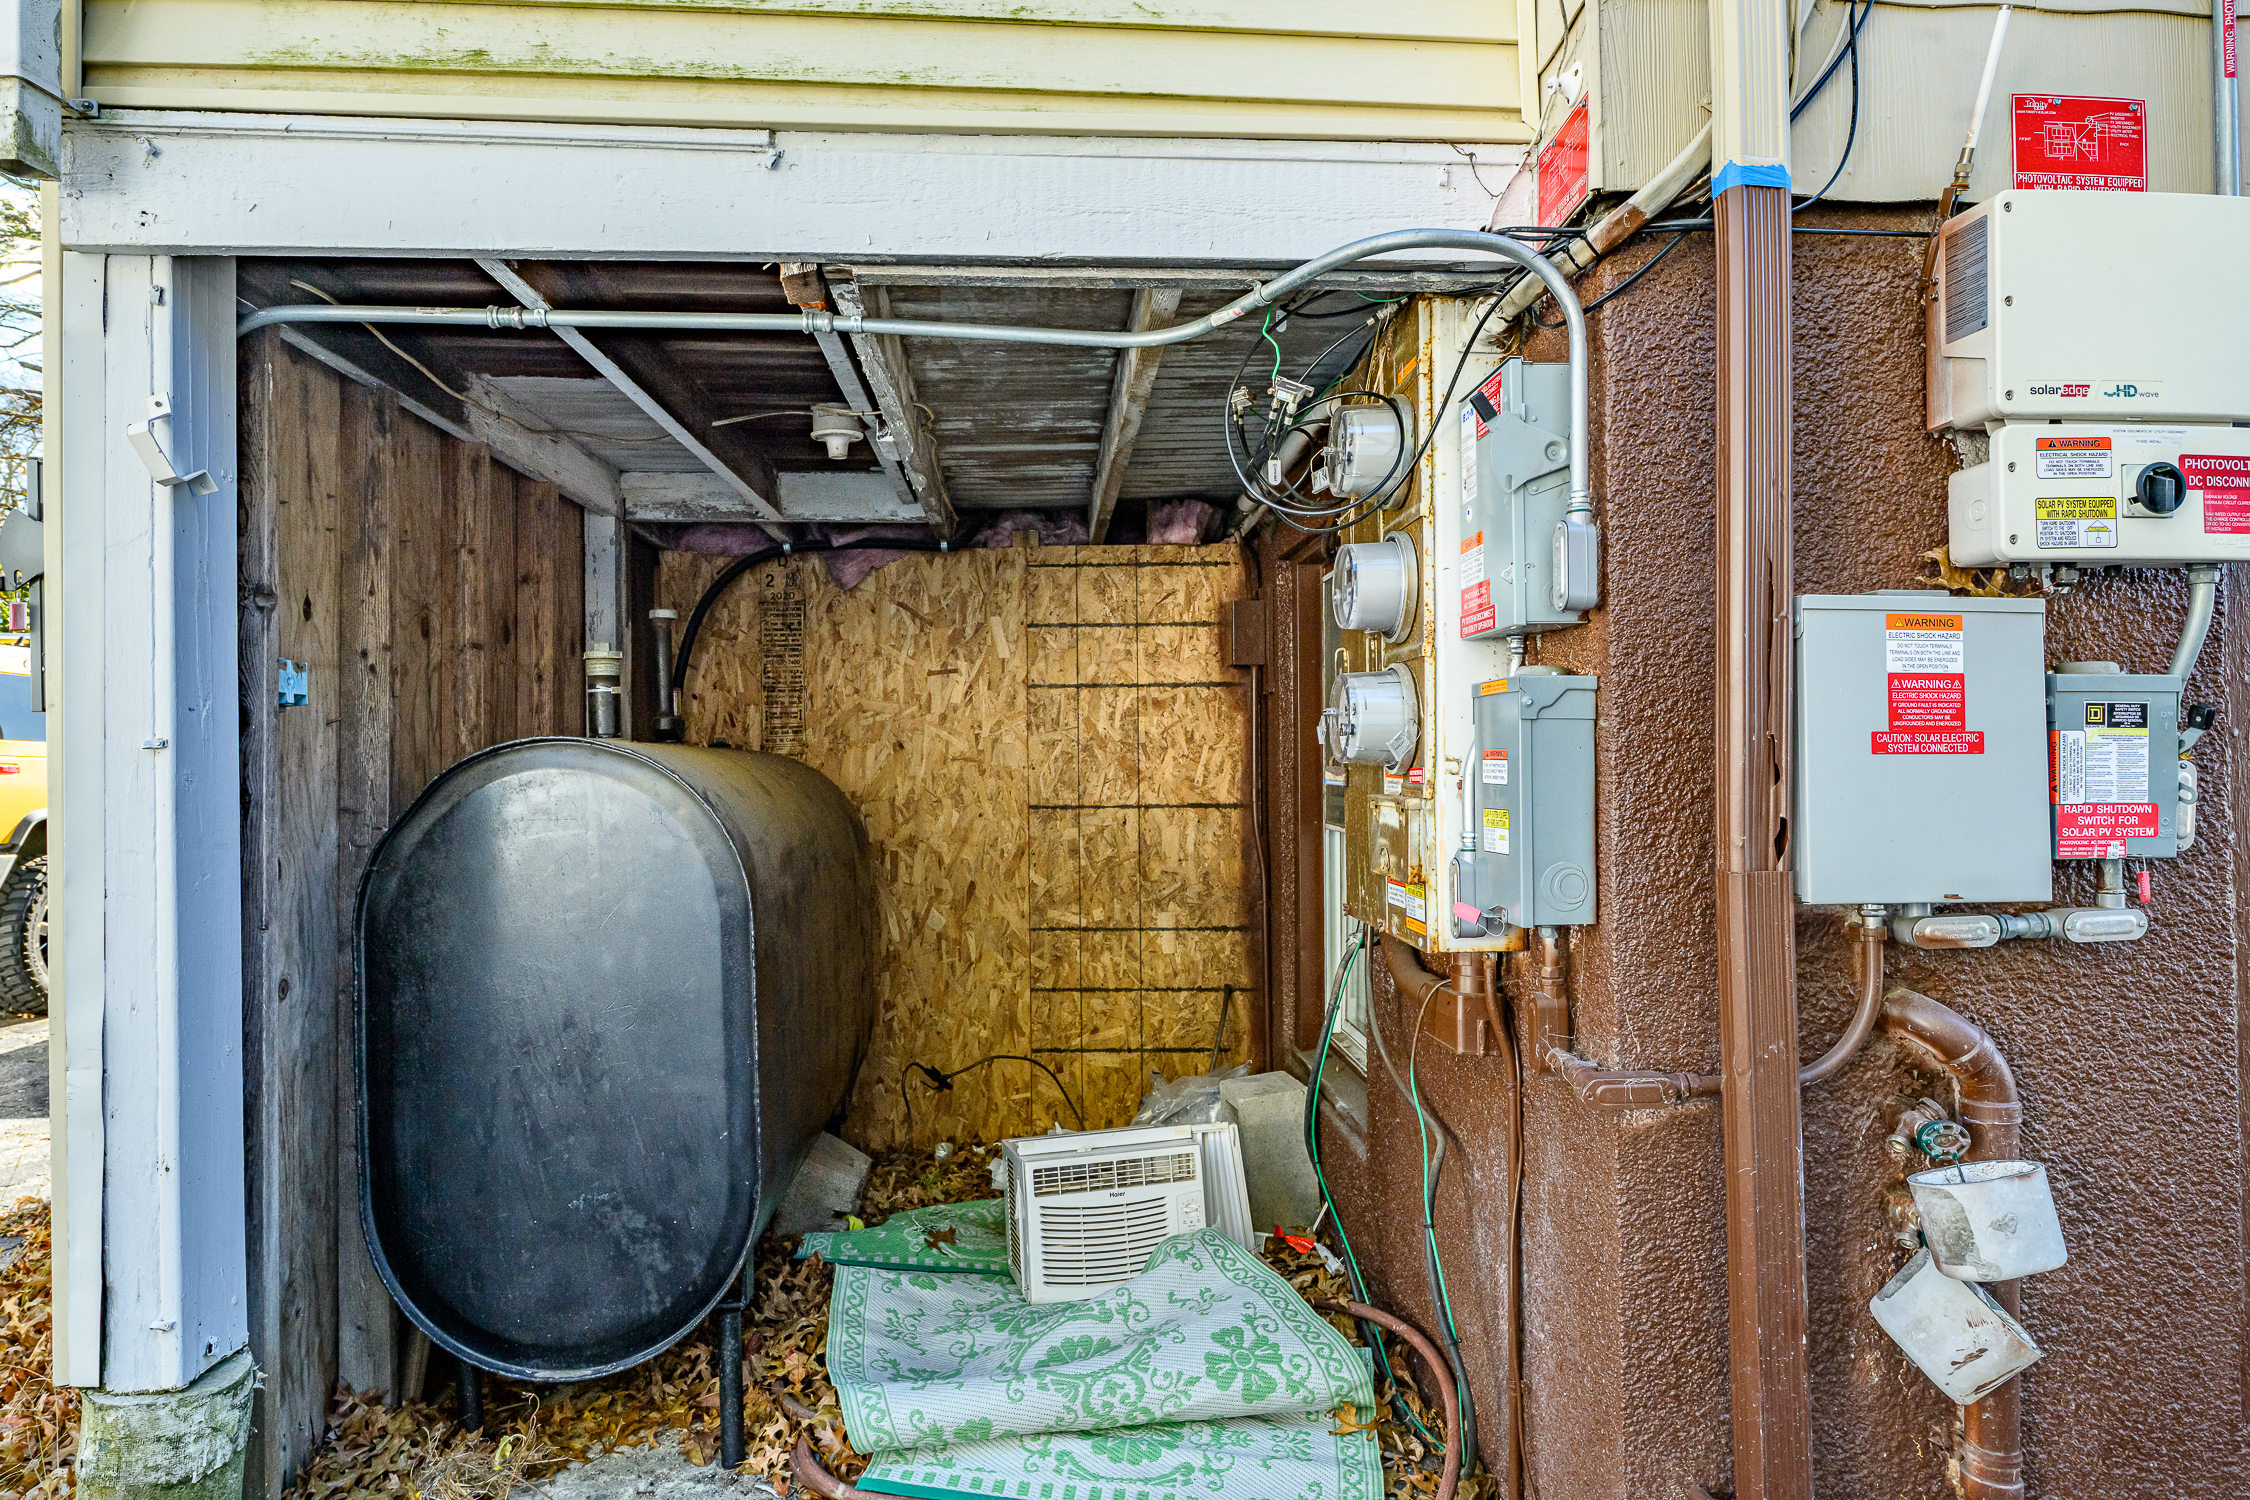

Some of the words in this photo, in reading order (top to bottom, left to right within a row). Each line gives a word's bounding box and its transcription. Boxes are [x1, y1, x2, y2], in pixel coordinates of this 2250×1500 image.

[2225, 0, 2233, 25] PHOT
[2225, 28, 2235, 73] WARNING:
[2025, 100, 2048, 109] Trinity
[2018, 174, 2073, 184] PHOTOVOLTAIC
[2076, 176, 2104, 185] SYSTEM
[2108, 177, 2143, 188] EQUIPPED
[2030, 384, 2090, 397] solaredge
[2116, 384, 2137, 397] HD
[2140, 450, 2155, 458] ON
[2189, 475, 2203, 486] DC
[2206, 476, 2250, 487] DISCONN
[2096, 485, 2116, 495] OFF
[2038, 500, 2055, 509] SOLAR
[2058, 500, 2064, 508] PV
[2066, 500, 2086, 508] SYSTEM
[2089, 500, 2114, 508] EQUIPPED
[2079, 510, 2108, 518] SHUTDOWN
[766, 574, 774, 587] 2
[770, 592, 795, 600] 2020
[1905, 619, 1954, 627] WARNING
[1902, 680, 1951, 689] WARNING
[1877, 734, 1913, 742] CAUTION:
[1915, 734, 1940, 742] SOLAR
[1942, 734, 1979, 742] ELECTRIC
[1888, 744, 1919, 752] SYSTEM
[1921, 744, 1968, 752] CONNECTED
[2064, 805, 2093, 813] RAPID
[2097, 805, 2151, 813] SHUTDOWN
[2078, 816, 2114, 825] SWITCH
[2119, 816, 2138, 825] FOR
[2062, 828, 2095, 836] SOLAR
[2100, 828, 2111, 836] PV
[2115, 828, 2154, 836] SYSTEM
